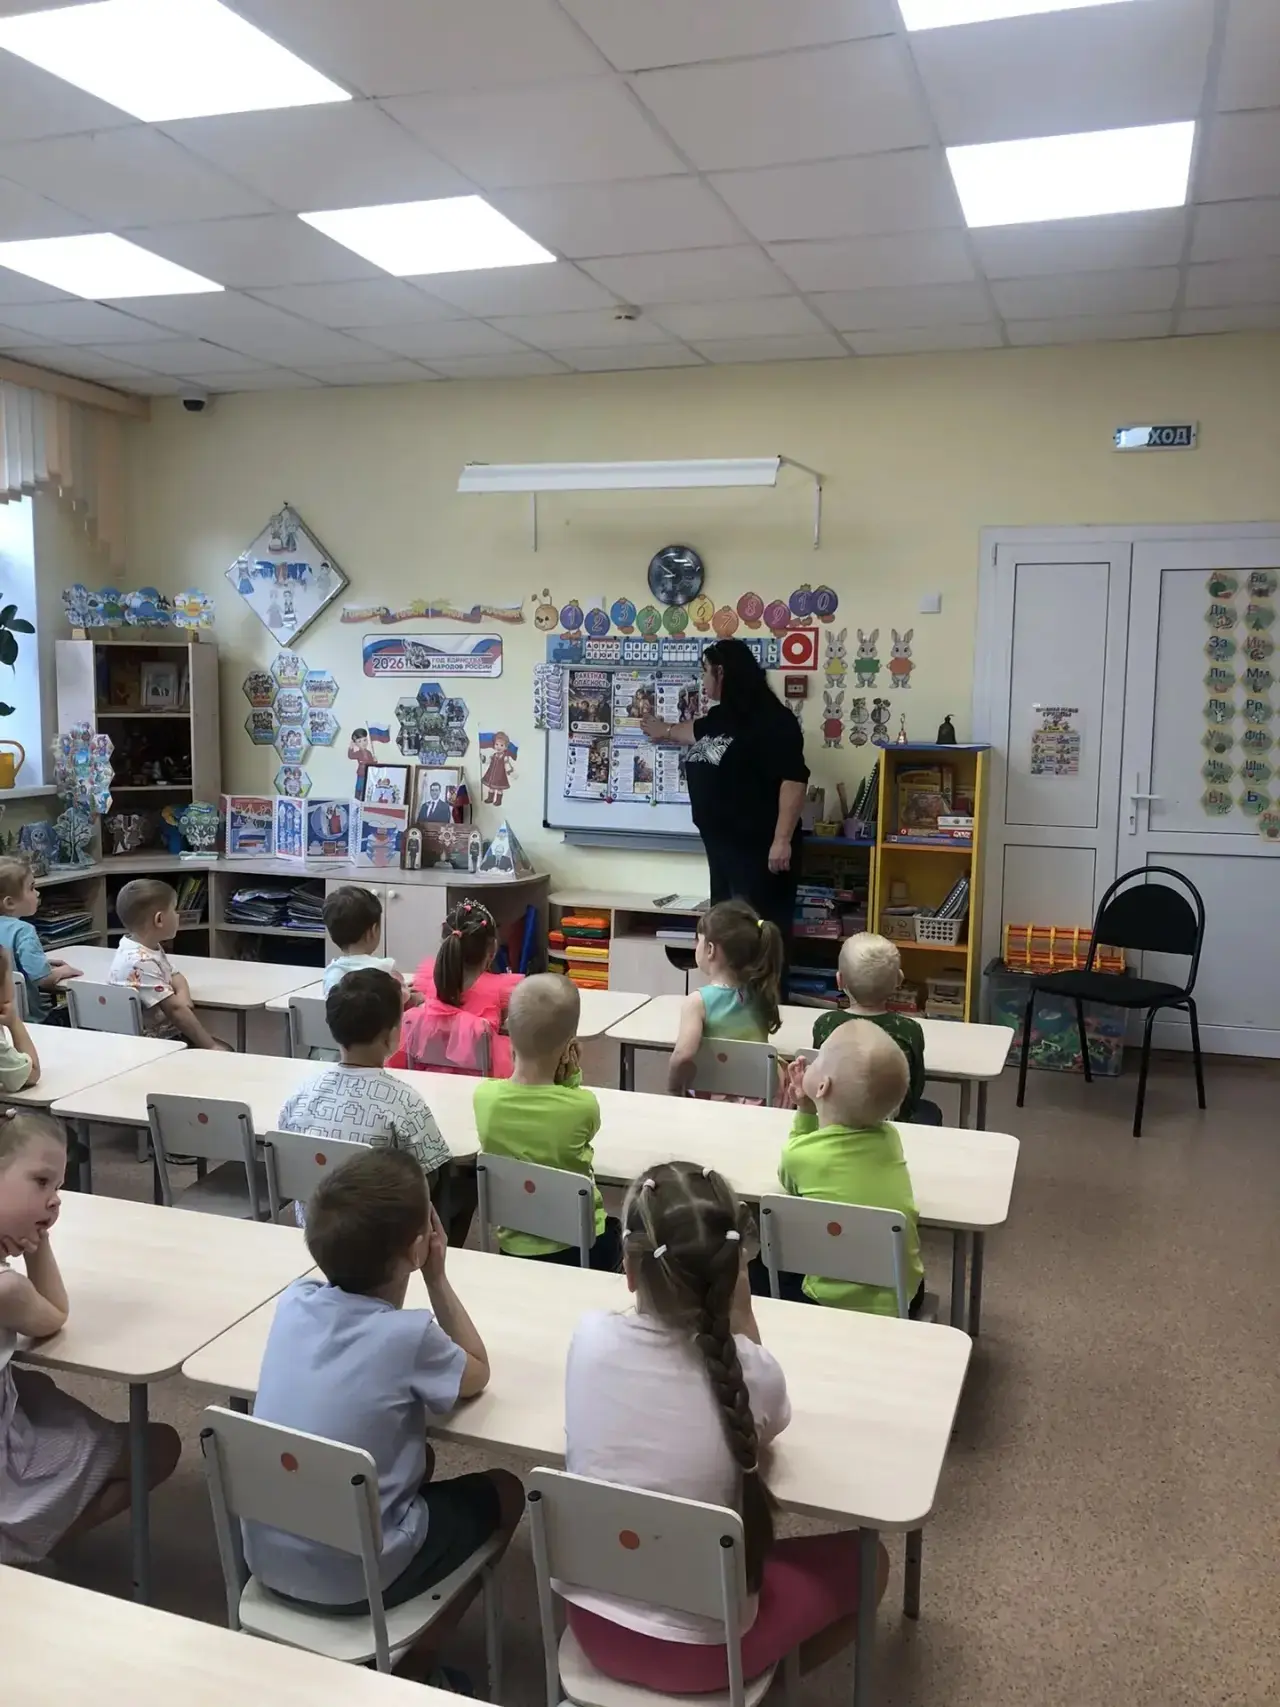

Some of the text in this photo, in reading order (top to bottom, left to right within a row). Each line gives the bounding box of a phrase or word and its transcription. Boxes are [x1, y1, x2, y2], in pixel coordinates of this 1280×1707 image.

[592, 615, 603, 632] 2
[618, 606, 628, 621] 3
[697, 602, 706, 618] 6
[720, 615, 734, 629] 7
[745, 600, 757, 616] 8
[772, 606, 784, 625] 9
[1209, 636, 1228, 648] Зз
[373, 657, 404, 670] 2026
[574, 679, 610, 687] ОПАСНОСТЬ
